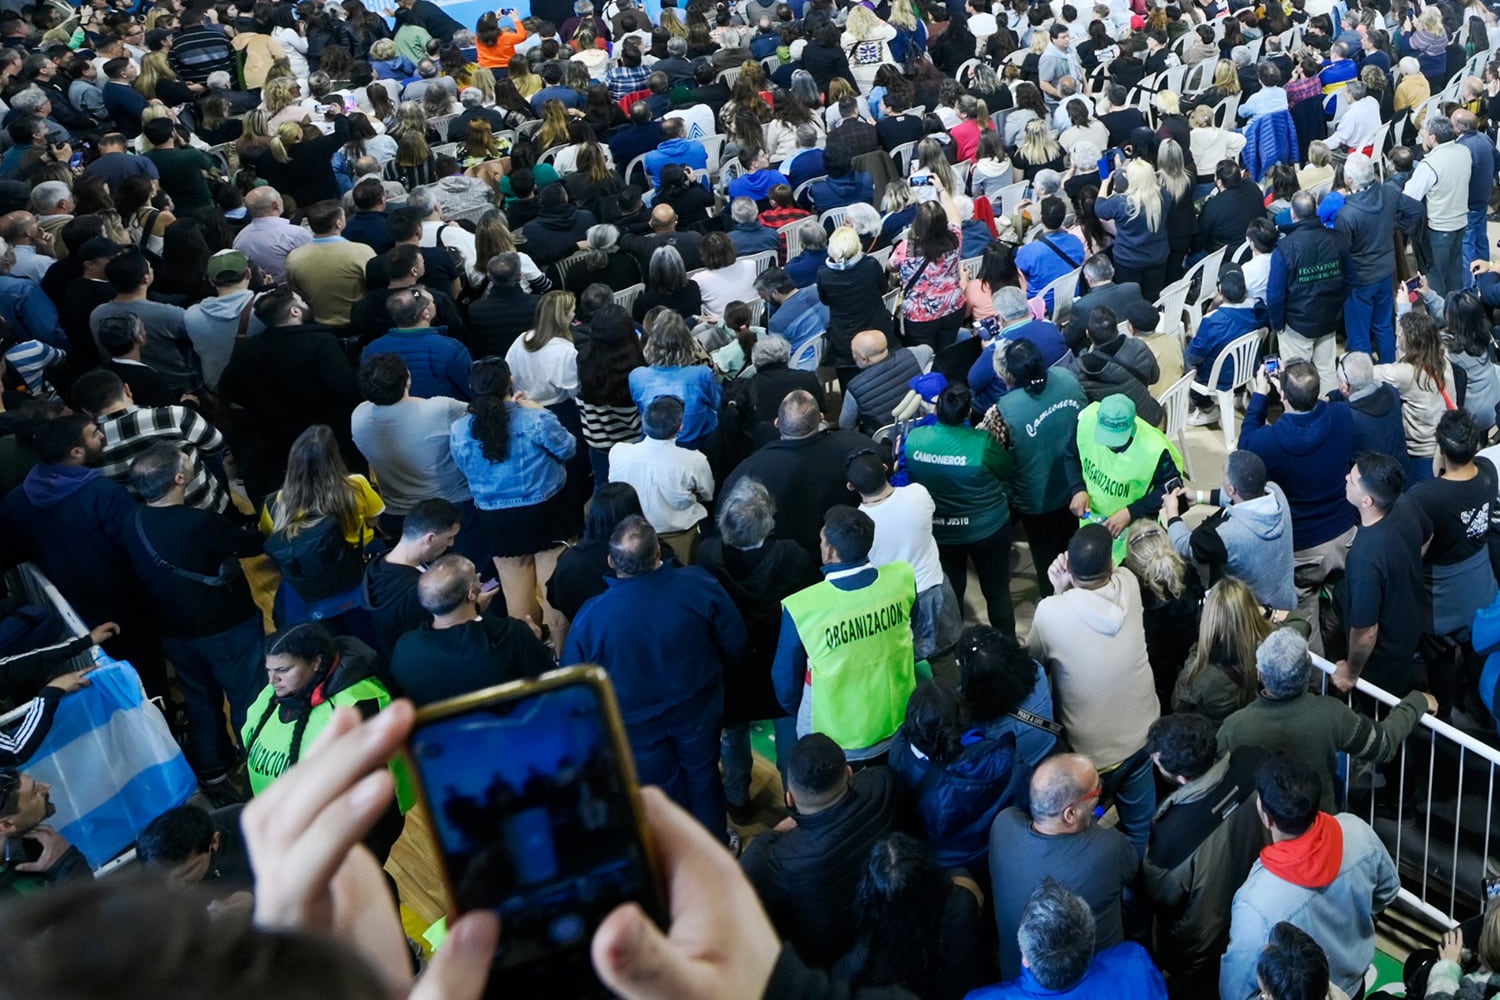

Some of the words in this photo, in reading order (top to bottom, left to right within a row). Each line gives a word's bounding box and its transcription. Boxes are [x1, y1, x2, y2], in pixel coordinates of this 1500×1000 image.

[913, 450, 968, 466] CAMIONEROS
[1083, 458, 1131, 498] ORGANIZACION
[946, 517, 970, 526] JUSTO
[825, 602, 903, 650] ORGANIZACION
